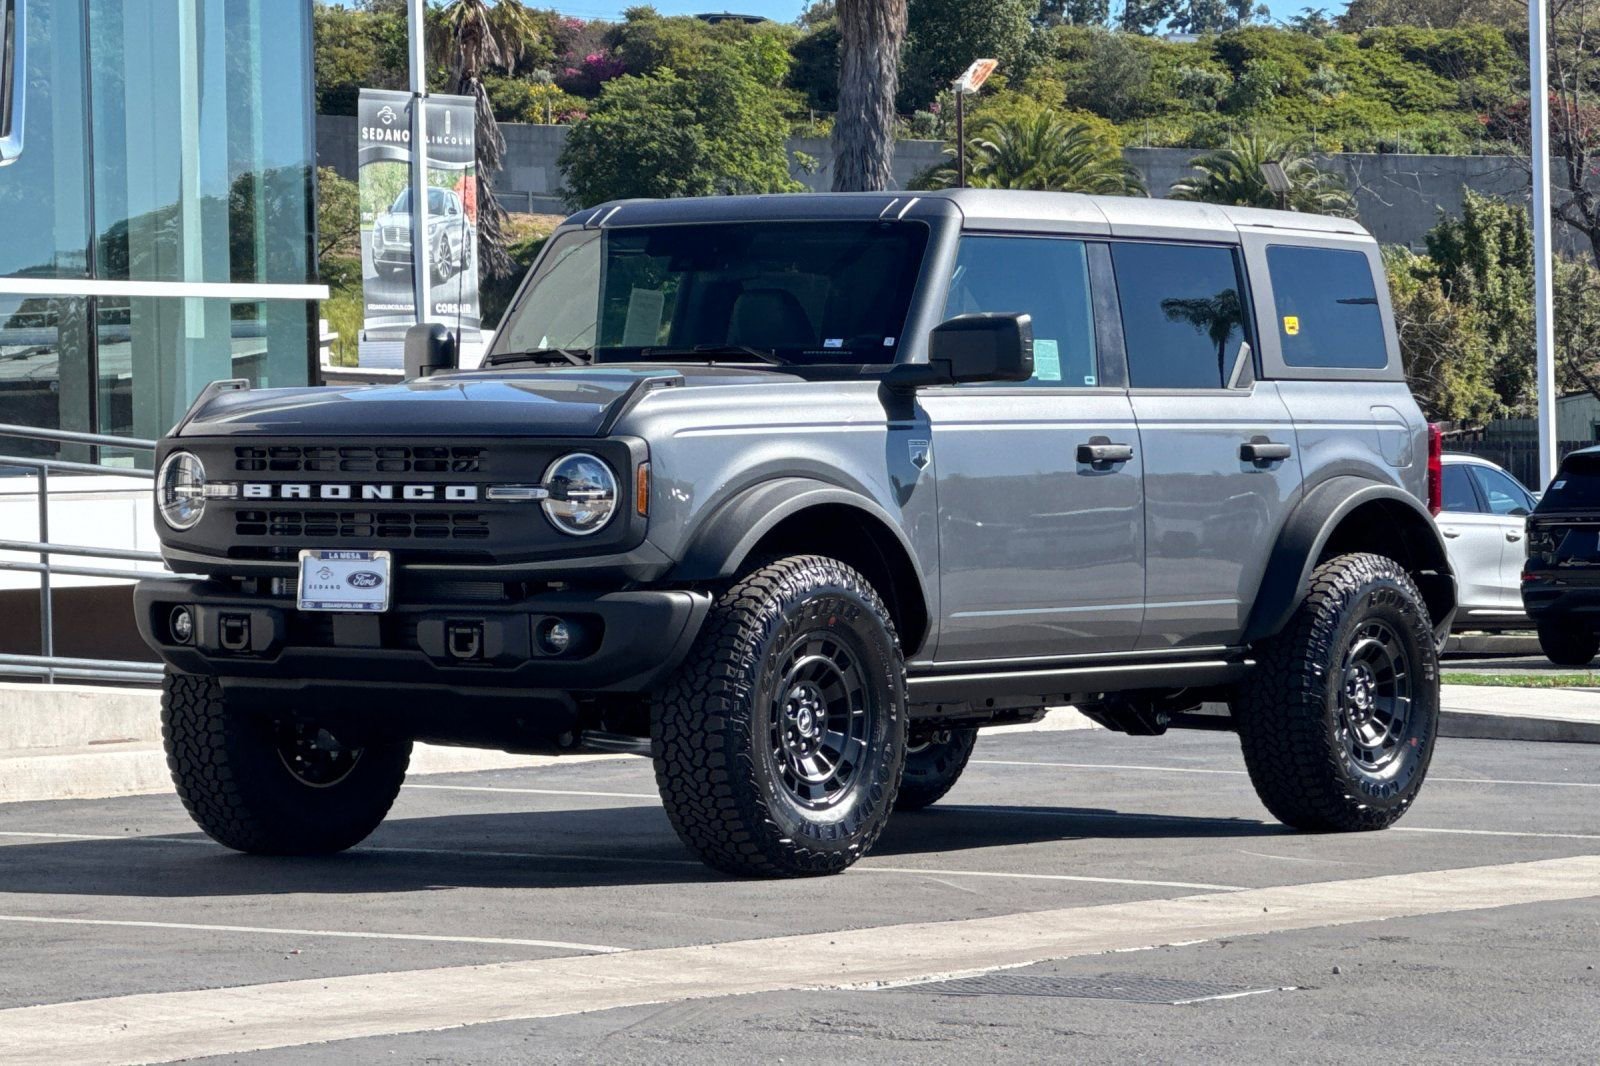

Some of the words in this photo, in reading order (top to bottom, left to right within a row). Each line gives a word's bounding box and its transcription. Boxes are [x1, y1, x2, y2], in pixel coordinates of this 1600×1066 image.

[361, 127, 411, 143] SEDANO
[425, 135, 472, 146] LINCOLN
[435, 303, 472, 314] CORSAIR
[242, 483, 478, 501] BRONCO
[340, 552, 361, 560] MESA
